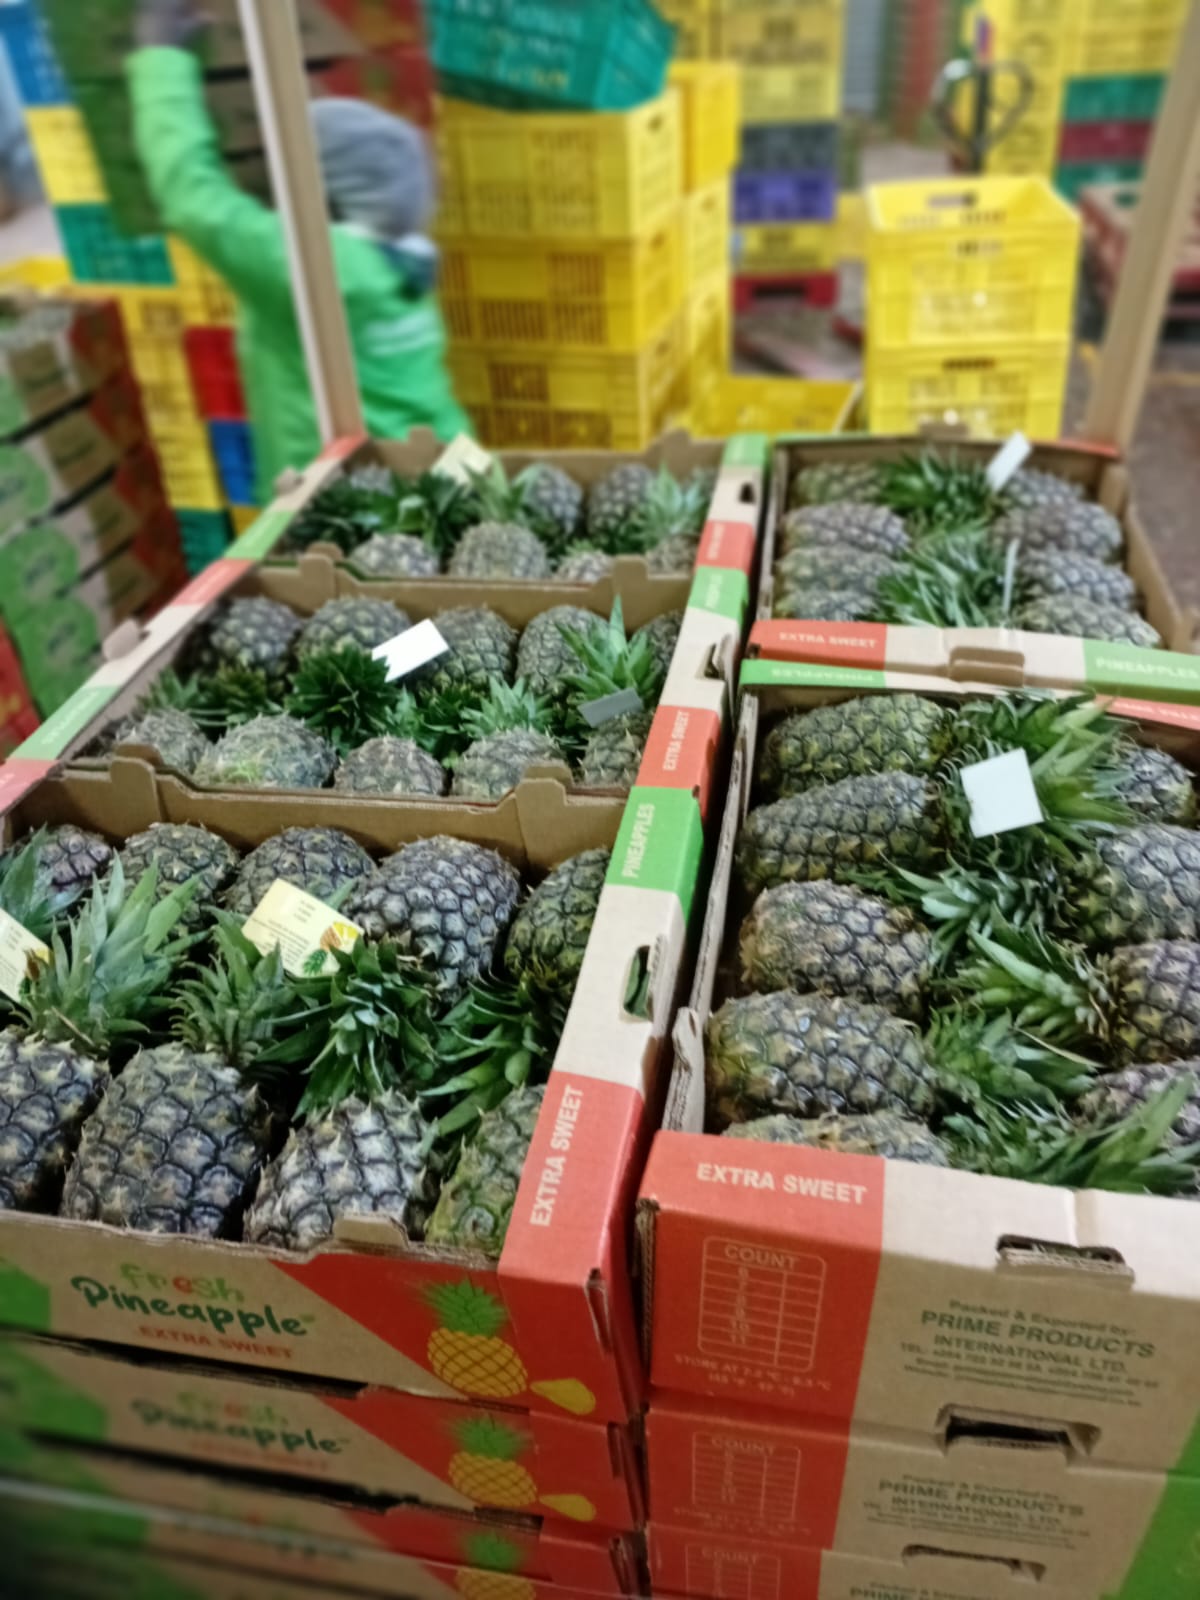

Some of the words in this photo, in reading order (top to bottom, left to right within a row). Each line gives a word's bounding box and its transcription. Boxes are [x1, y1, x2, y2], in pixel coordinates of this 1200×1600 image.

[779, 632, 825, 644] EXTRA
[829, 636, 876, 649] SWEET
[1095, 657, 1199, 678] PINEAPPLES
[621, 802, 656, 879] PINEAPPLES
[529, 1155, 567, 1227] EXTRA
[550, 1083, 585, 1151] SWEET
[696, 1162, 776, 1191] EXTRA
[782, 1174, 868, 1205] SWEET
[724, 1244, 799, 1269] COUNT
[70, 1275, 308, 1338] Pineapple
[138, 1325, 211, 1346] EXTRA
[218, 1338, 293, 1359] SWEET
[920, 1309, 1001, 1337] PRIME
[1008, 1323, 1156, 1358] PRODUCTS
[934, 1334, 1082, 1368] INTERNATIONAL
[879, 1478, 949, 1500] PRIME
[955, 1491, 1085, 1517] PRODUCTS
[892, 1496, 1023, 1522] INTERNATIONAL
